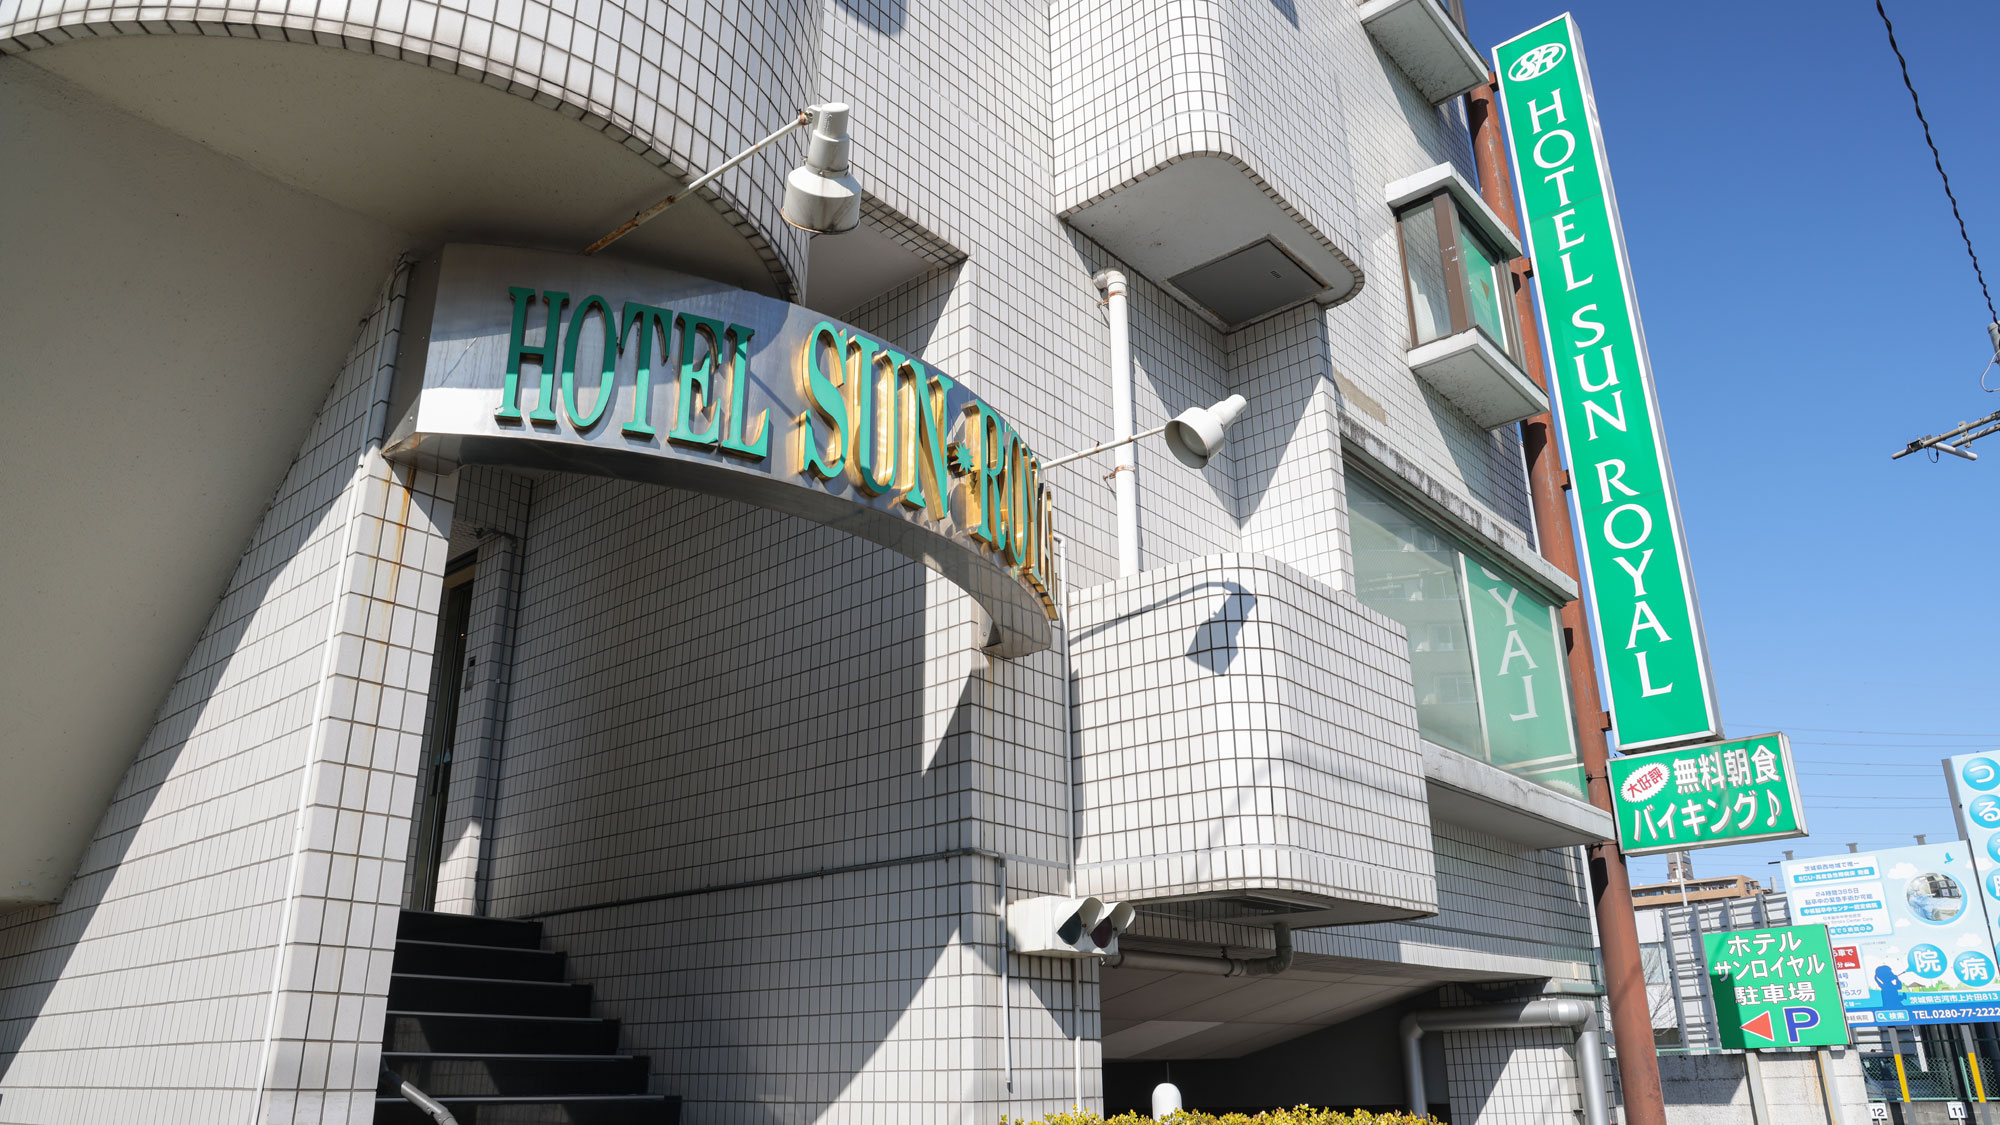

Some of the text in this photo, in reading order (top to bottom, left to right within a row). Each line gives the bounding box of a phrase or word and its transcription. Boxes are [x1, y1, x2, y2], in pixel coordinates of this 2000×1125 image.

[1527, 88, 1673, 698] HOTEL SUN ROYAL
[495, 286, 1059, 621] HOTEL SUN ROYA
[1627, 767, 1663, 798] 大好評
[1672, 744, 1781, 795] 無料朝食
[1727, 931, 1802, 957] ホテル
[1714, 954, 1825, 982] サンロイヤル
[1913, 949, 1989, 981] 院 病
[1734, 981, 1816, 1006] 駐車場
[1783, 1006, 1820, 1043] P
[1872, 1108, 1884, 1117] 12
[1952, 1107, 1963, 1116] 11
